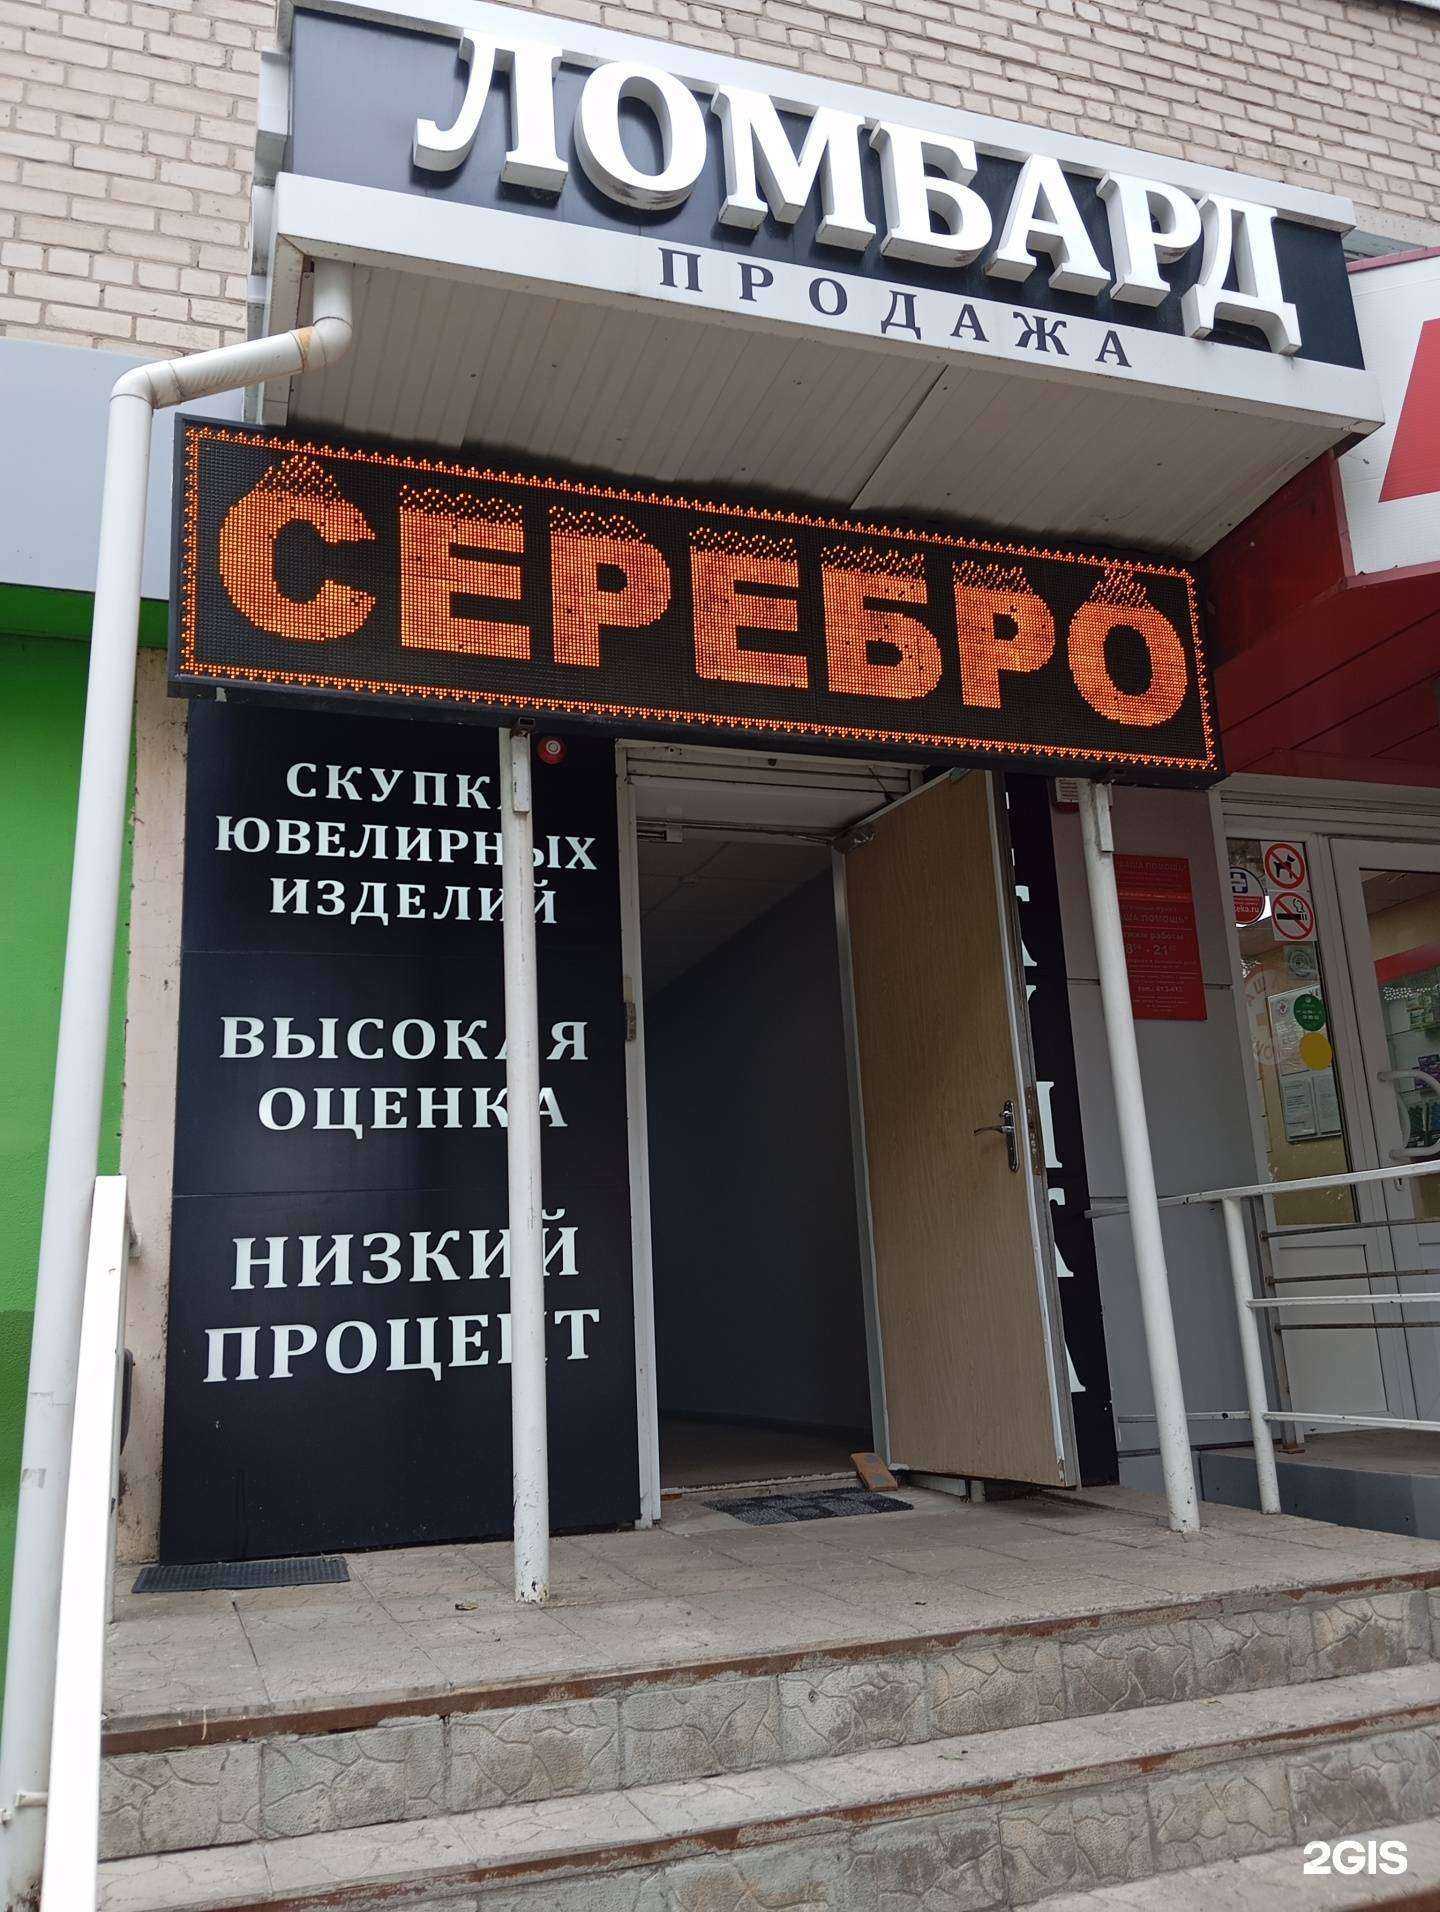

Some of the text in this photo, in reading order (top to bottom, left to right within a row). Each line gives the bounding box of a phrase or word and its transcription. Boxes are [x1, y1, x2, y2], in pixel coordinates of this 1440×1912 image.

[414, 29, 1302, 356] ЛОМБАРД
[658, 247, 1132, 368] ПРОДАЖА
[218, 453, 1188, 727] СЕРЕБРО
[286, 762, 502, 810] СКУПК
[219, 1016, 589, 1061] ВЫСОКЯ
